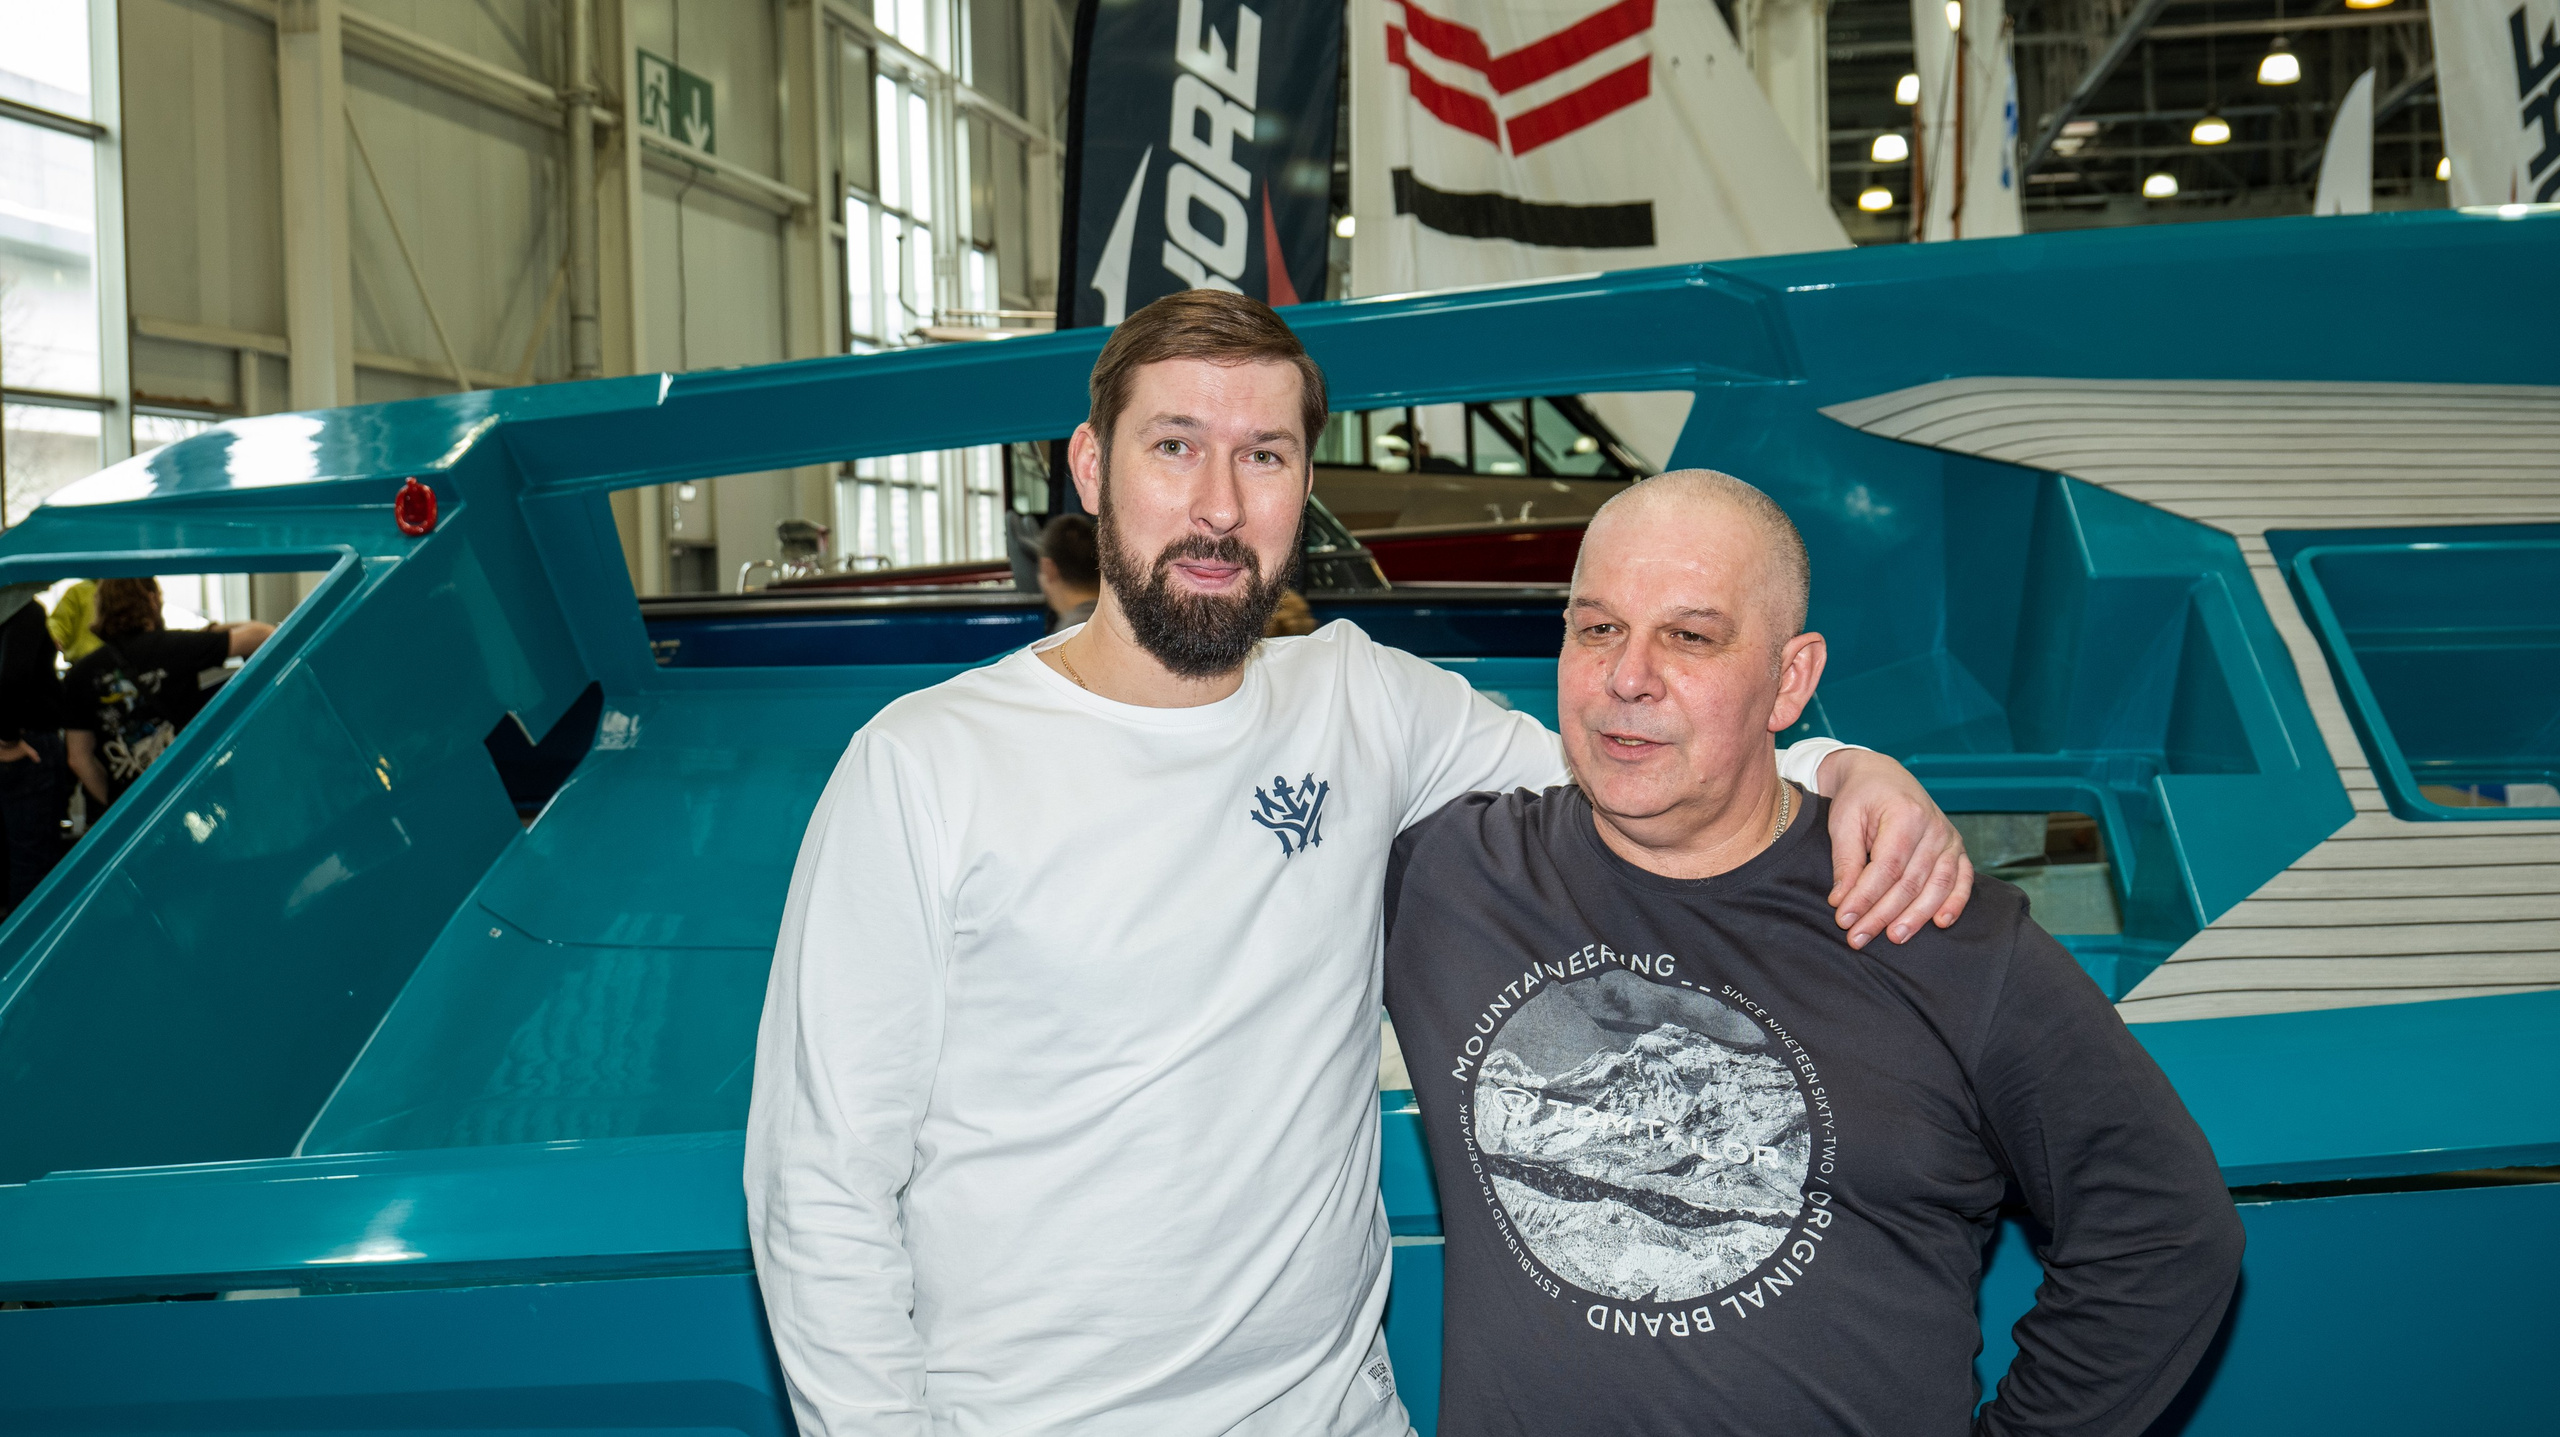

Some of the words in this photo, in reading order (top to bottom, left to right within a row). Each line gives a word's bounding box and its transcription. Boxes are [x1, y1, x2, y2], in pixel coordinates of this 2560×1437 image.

[1452, 943, 1676, 1082] MOUNTAINEERING
[1721, 984, 1768, 1018] SINCE
[1765, 1018, 1820, 1085] NINETEEN
[1811, 1086, 1837, 1174] SIXTY-TWO
[1459, 1103, 1496, 1206] TRADEMARK
[1547, 1098, 1632, 1136] TOM
[1639, 1117, 1779, 1168] TAILOR
[1492, 1208, 1561, 1299] ESTABLISHED
[1720, 1191, 1832, 1319] ORIGINAL
[1586, 1304, 1716, 1338] BRAND
